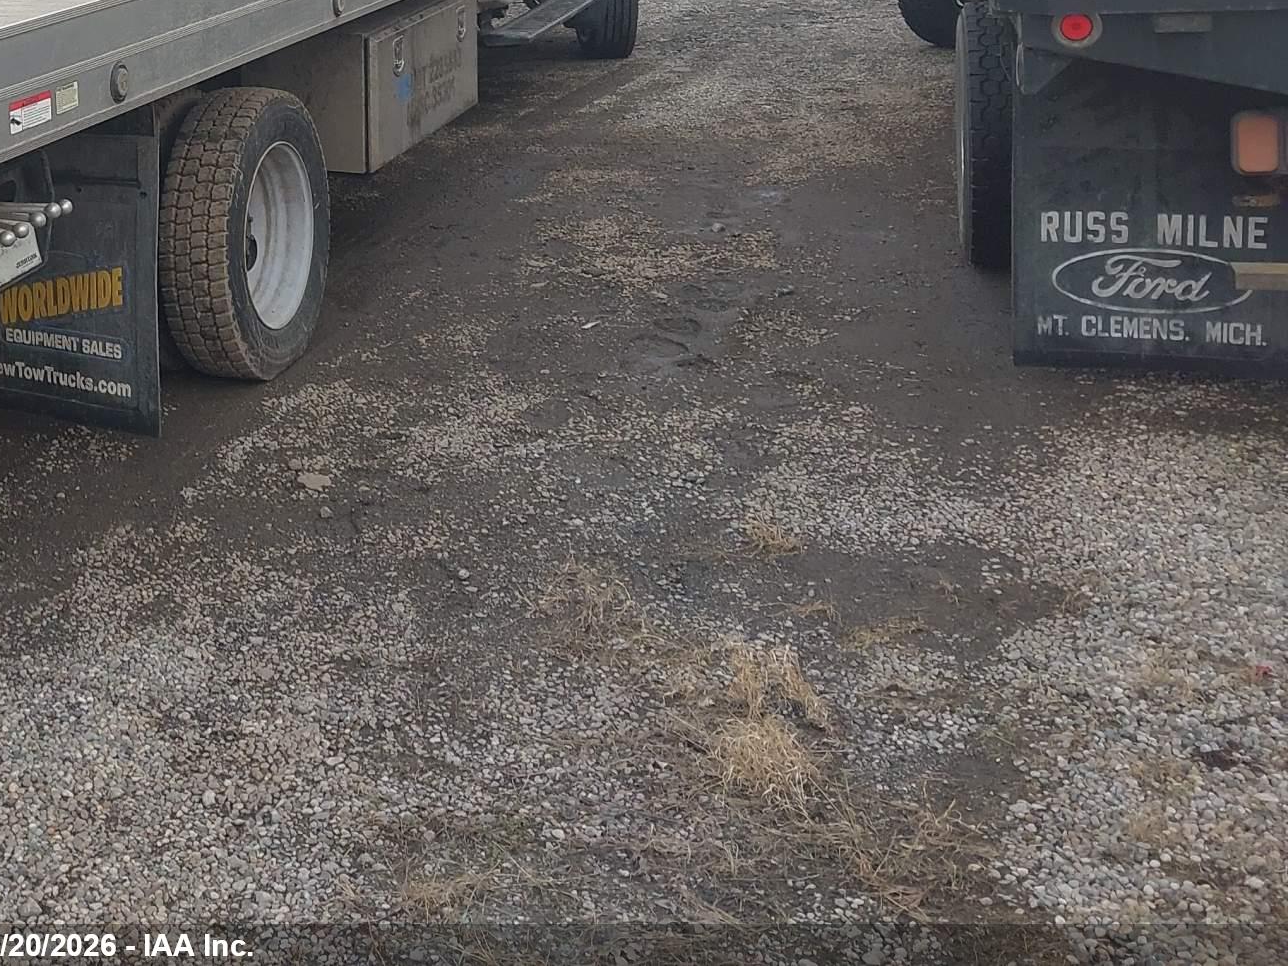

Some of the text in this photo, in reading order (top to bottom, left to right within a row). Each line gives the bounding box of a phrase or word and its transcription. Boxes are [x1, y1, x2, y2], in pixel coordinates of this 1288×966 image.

[1040, 211, 1269, 249] RUSS MILNE
[1091, 254, 1212, 302] Ford
[5, 328, 122, 360] EQUIPMENT SALES
[1037, 314, 1069, 336] MT.
[1206, 321, 1268, 346] MICH.
